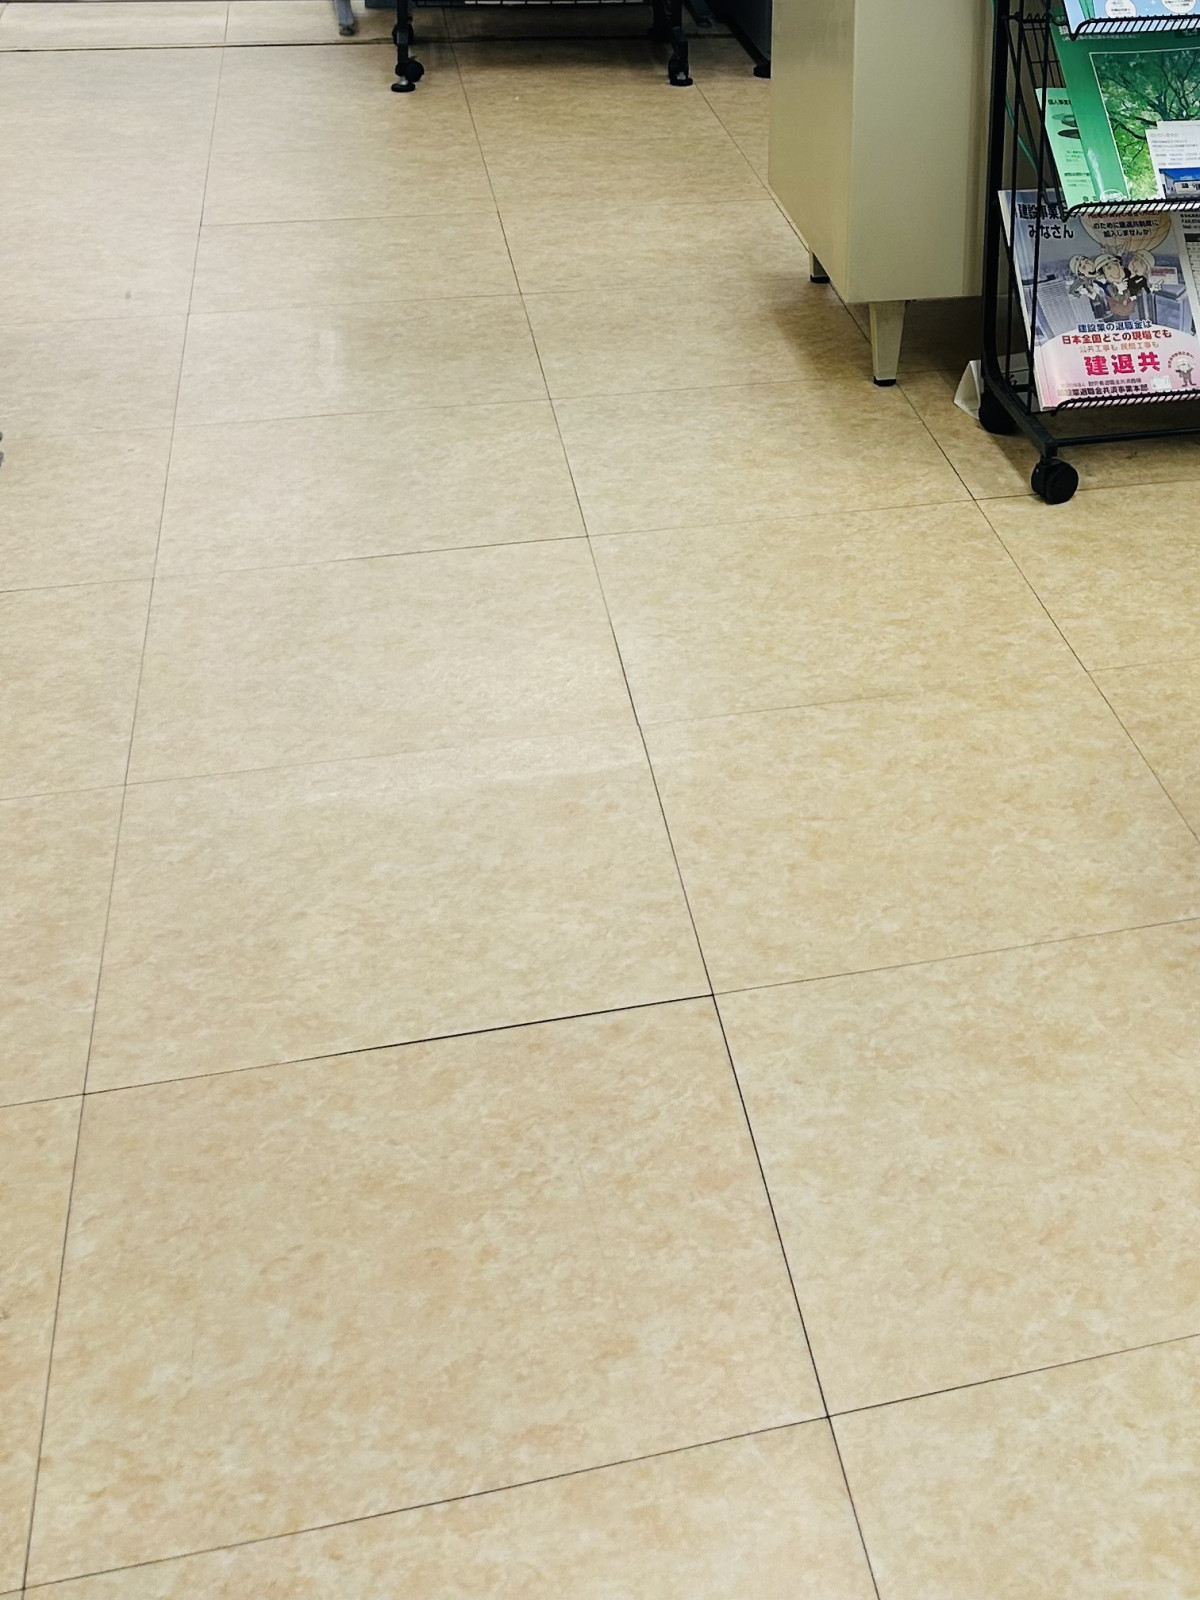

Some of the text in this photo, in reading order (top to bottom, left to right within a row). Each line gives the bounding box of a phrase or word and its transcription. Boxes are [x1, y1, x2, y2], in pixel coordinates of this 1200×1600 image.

[1028, 224, 1074, 239] みなさん
[1078, 320, 1152, 333] 建設業の退職金は
[1062, 329, 1172, 345] 日本全国どこの現場でも
[1084, 352, 1160, 376] 建退共
